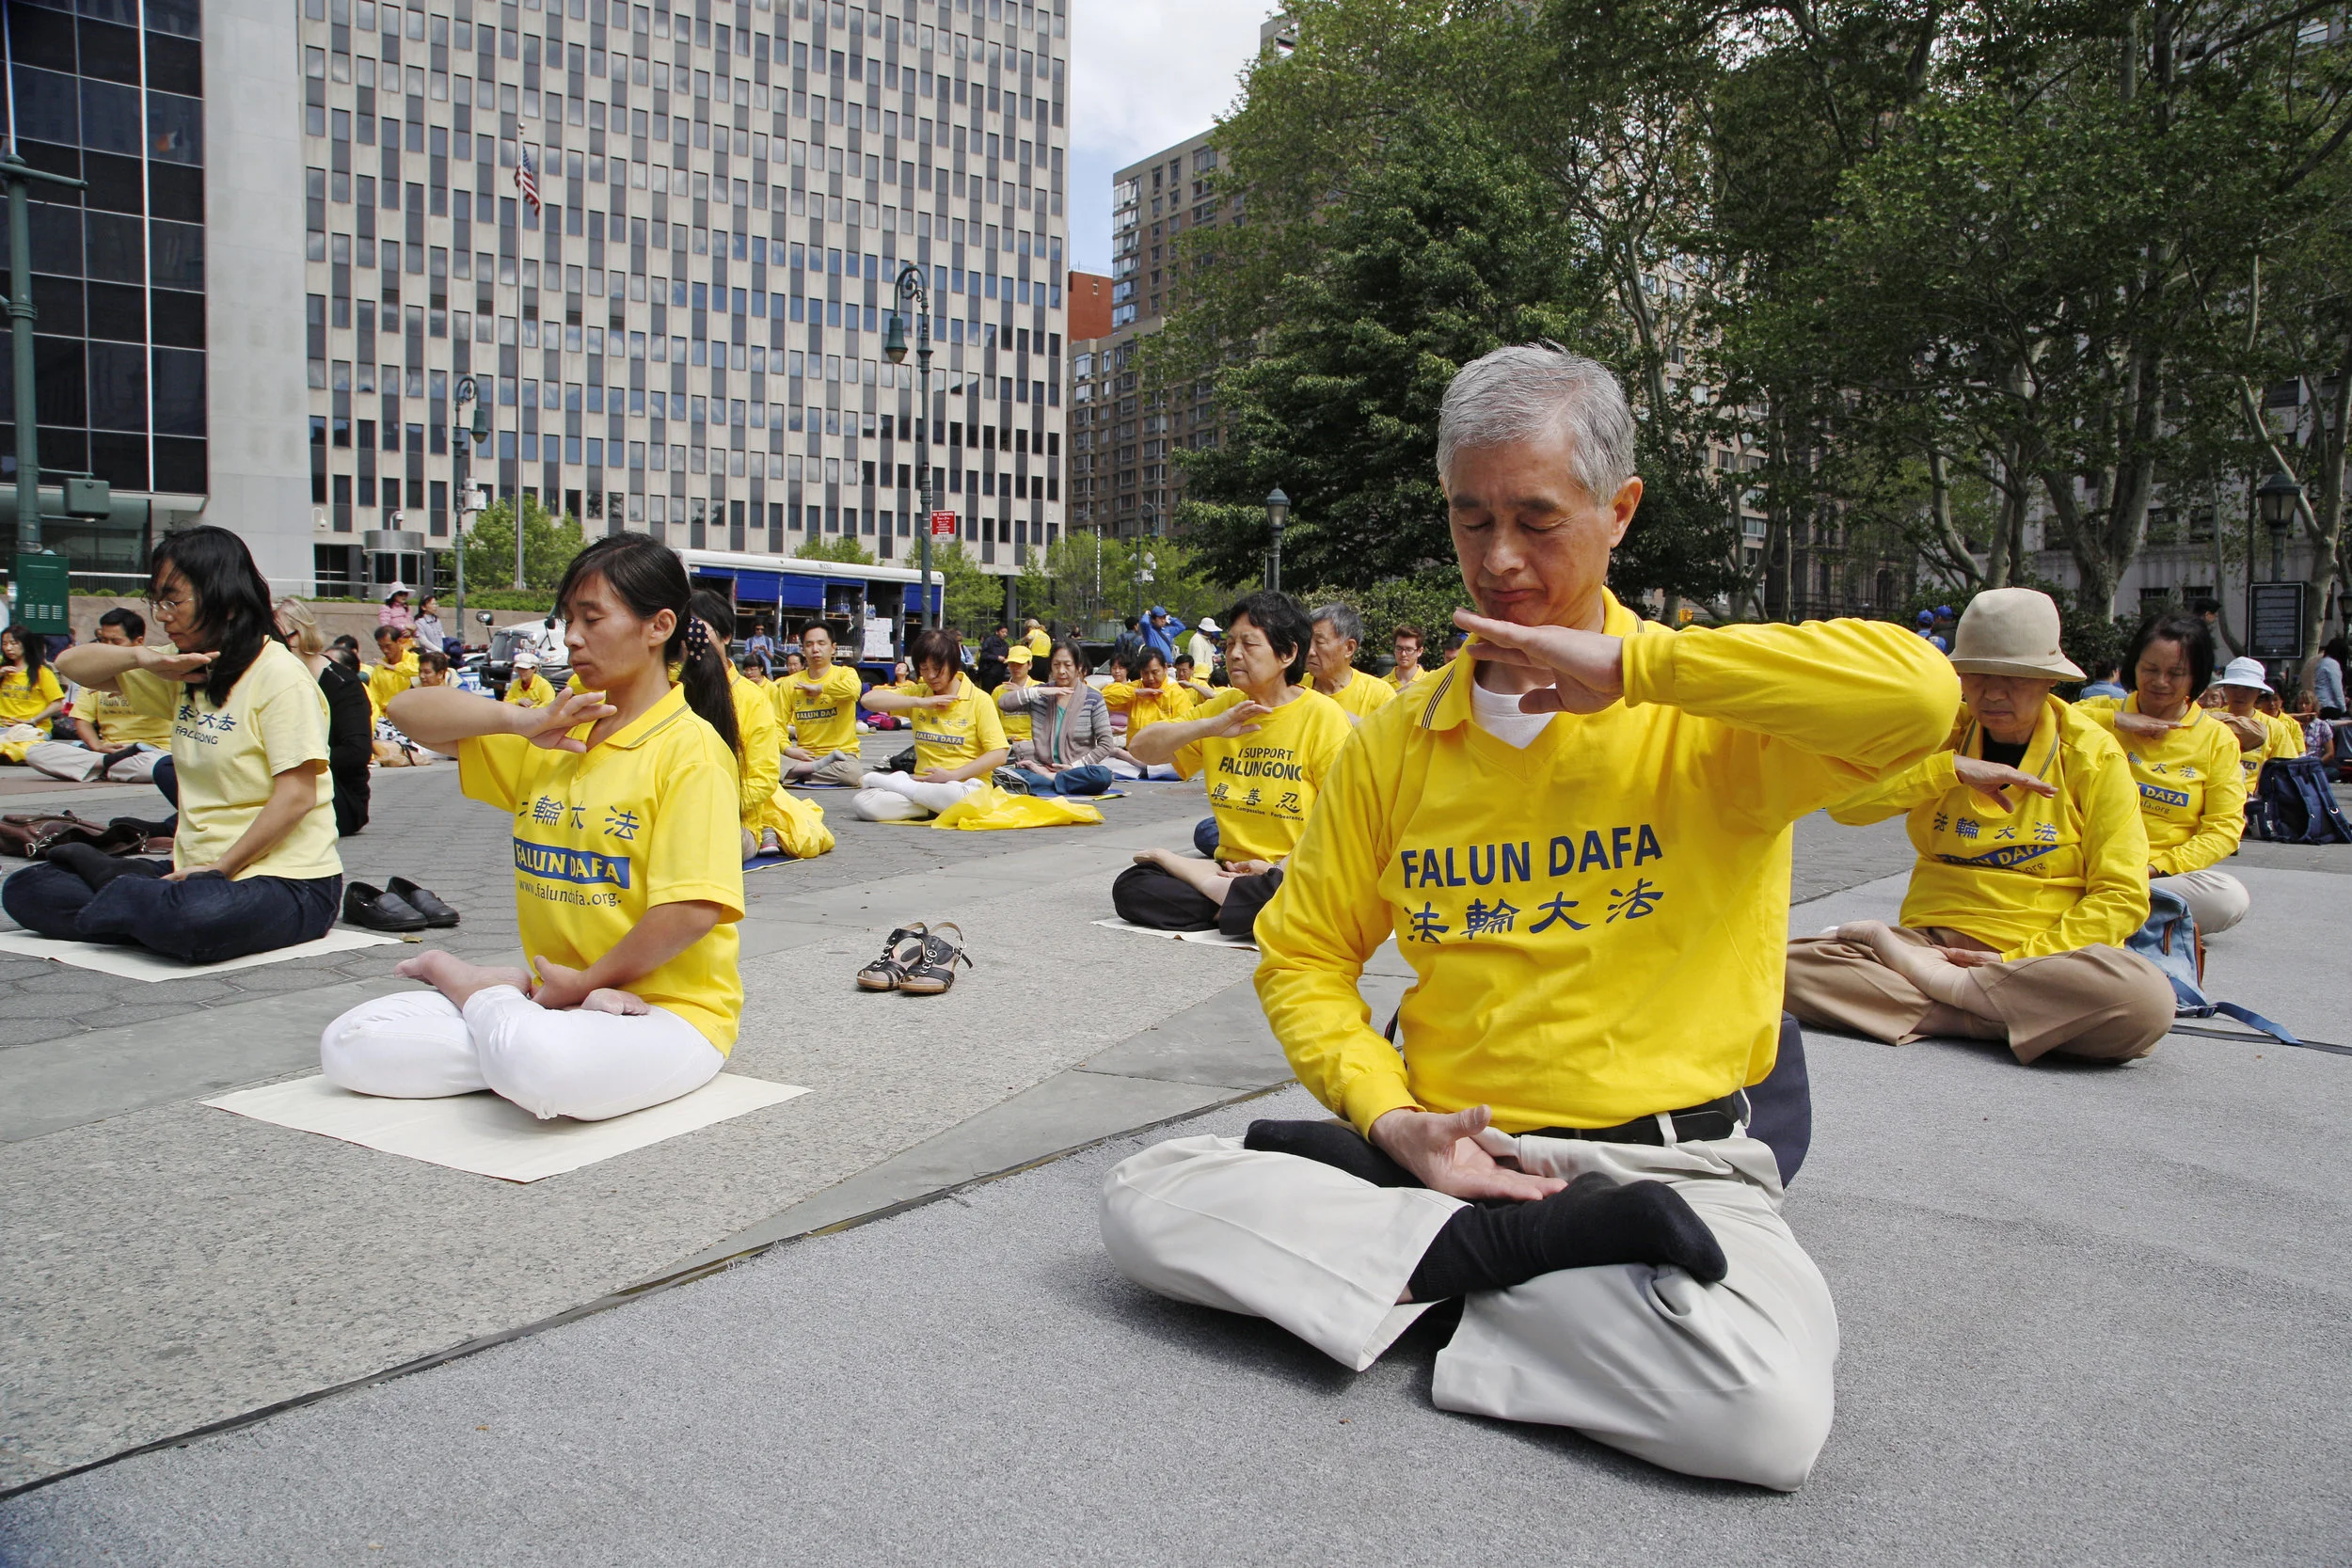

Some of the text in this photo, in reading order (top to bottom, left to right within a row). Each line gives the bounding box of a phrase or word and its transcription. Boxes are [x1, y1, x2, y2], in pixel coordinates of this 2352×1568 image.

[797, 708, 836, 720] FALUN DAA
[916, 733, 939, 742] FALUN
[1238, 747, 1295, 761] I SUPPORT
[2145, 787, 2185, 805] DAFA
[516, 843, 622, 883] FALUN DAFA
[1400, 823, 1664, 889] FALUN DAFA
[1403, 877, 1665, 944] 法輪大法
